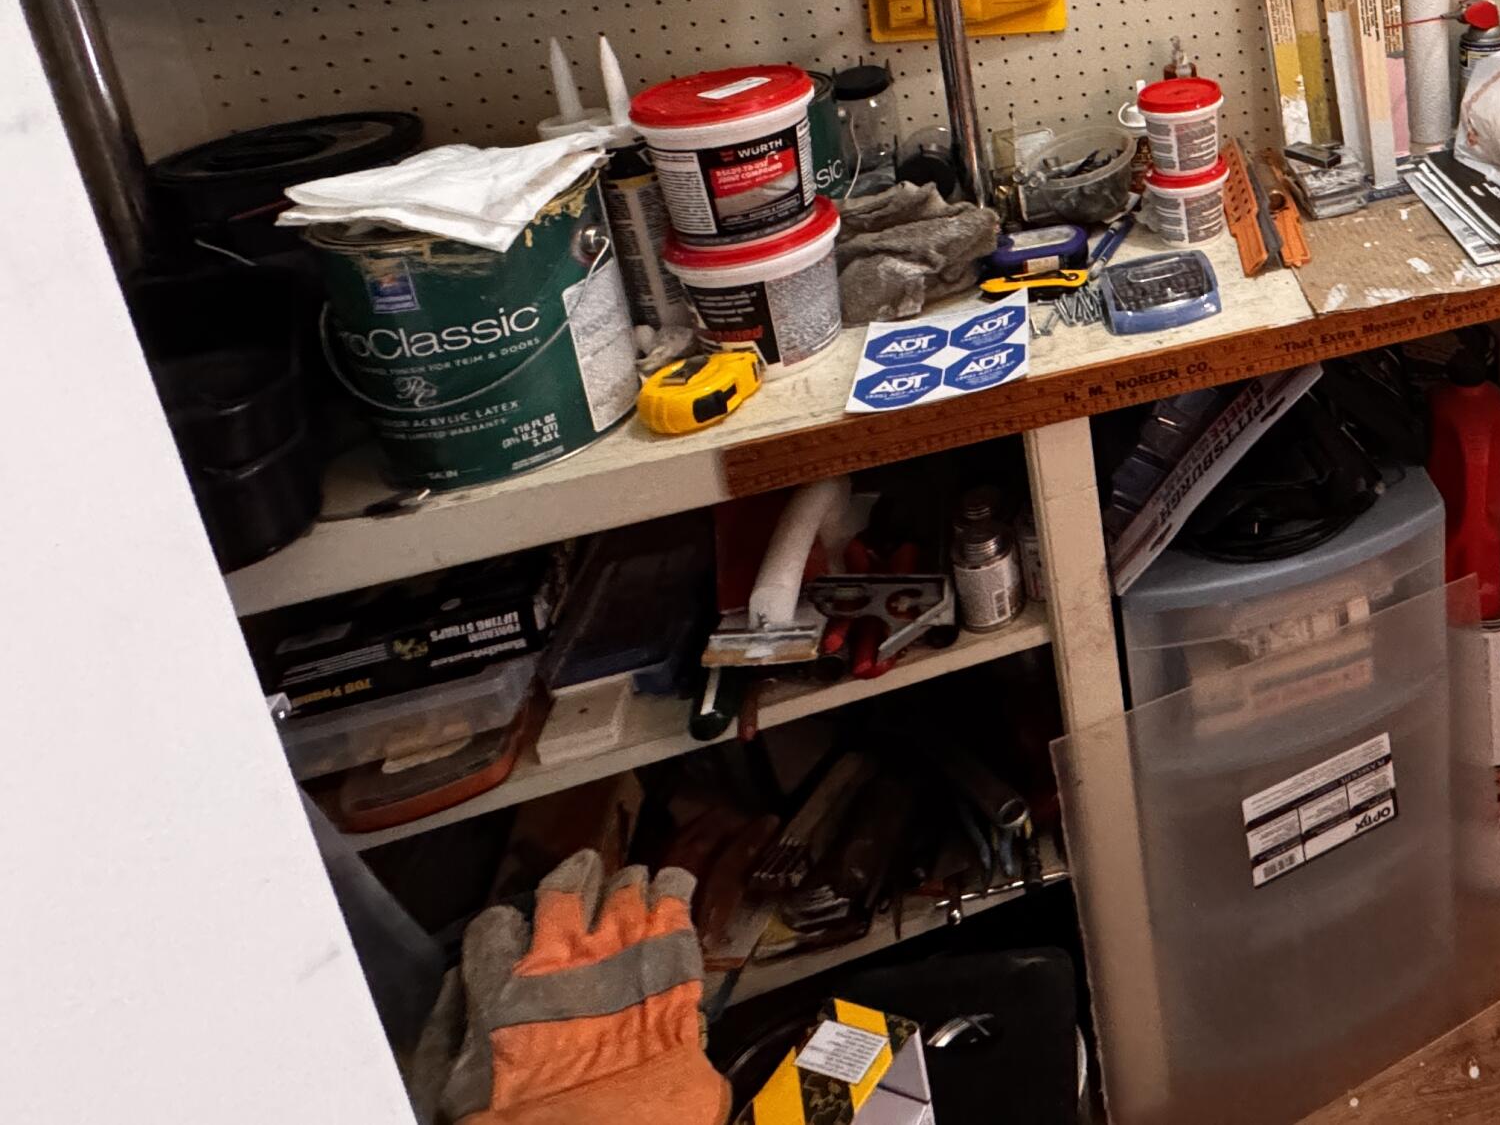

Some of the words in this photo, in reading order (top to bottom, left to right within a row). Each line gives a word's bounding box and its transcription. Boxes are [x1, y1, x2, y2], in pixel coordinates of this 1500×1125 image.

[965, 310, 1016, 339] ADT
[1320, 328, 1357, 347] Extra
[1362, 315, 1418, 337] Measure
[1421, 308, 1438, 321] Of
[453, 354, 484, 367] TRIM
[487, 351, 497, 360] &
[500, 337, 541, 356] DOORS
[880, 334, 937, 355] ADT
[959, 347, 1015, 376] ADT
[870, 373, 931, 395] ADT
[1063, 389, 1081, 404] H.
[1088, 384, 1108, 399] M.
[1115, 367, 1180, 392] NOREEN
[1185, 361, 1214, 376] CO.
[413, 411, 470, 428] ACRYLIC
[475, 400, 520, 419] LATEX
[1159, 396, 1266, 525] PITTSBURGH
[429, 621, 473, 643] STRAPS
[475, 611, 519, 633] LIFTING
